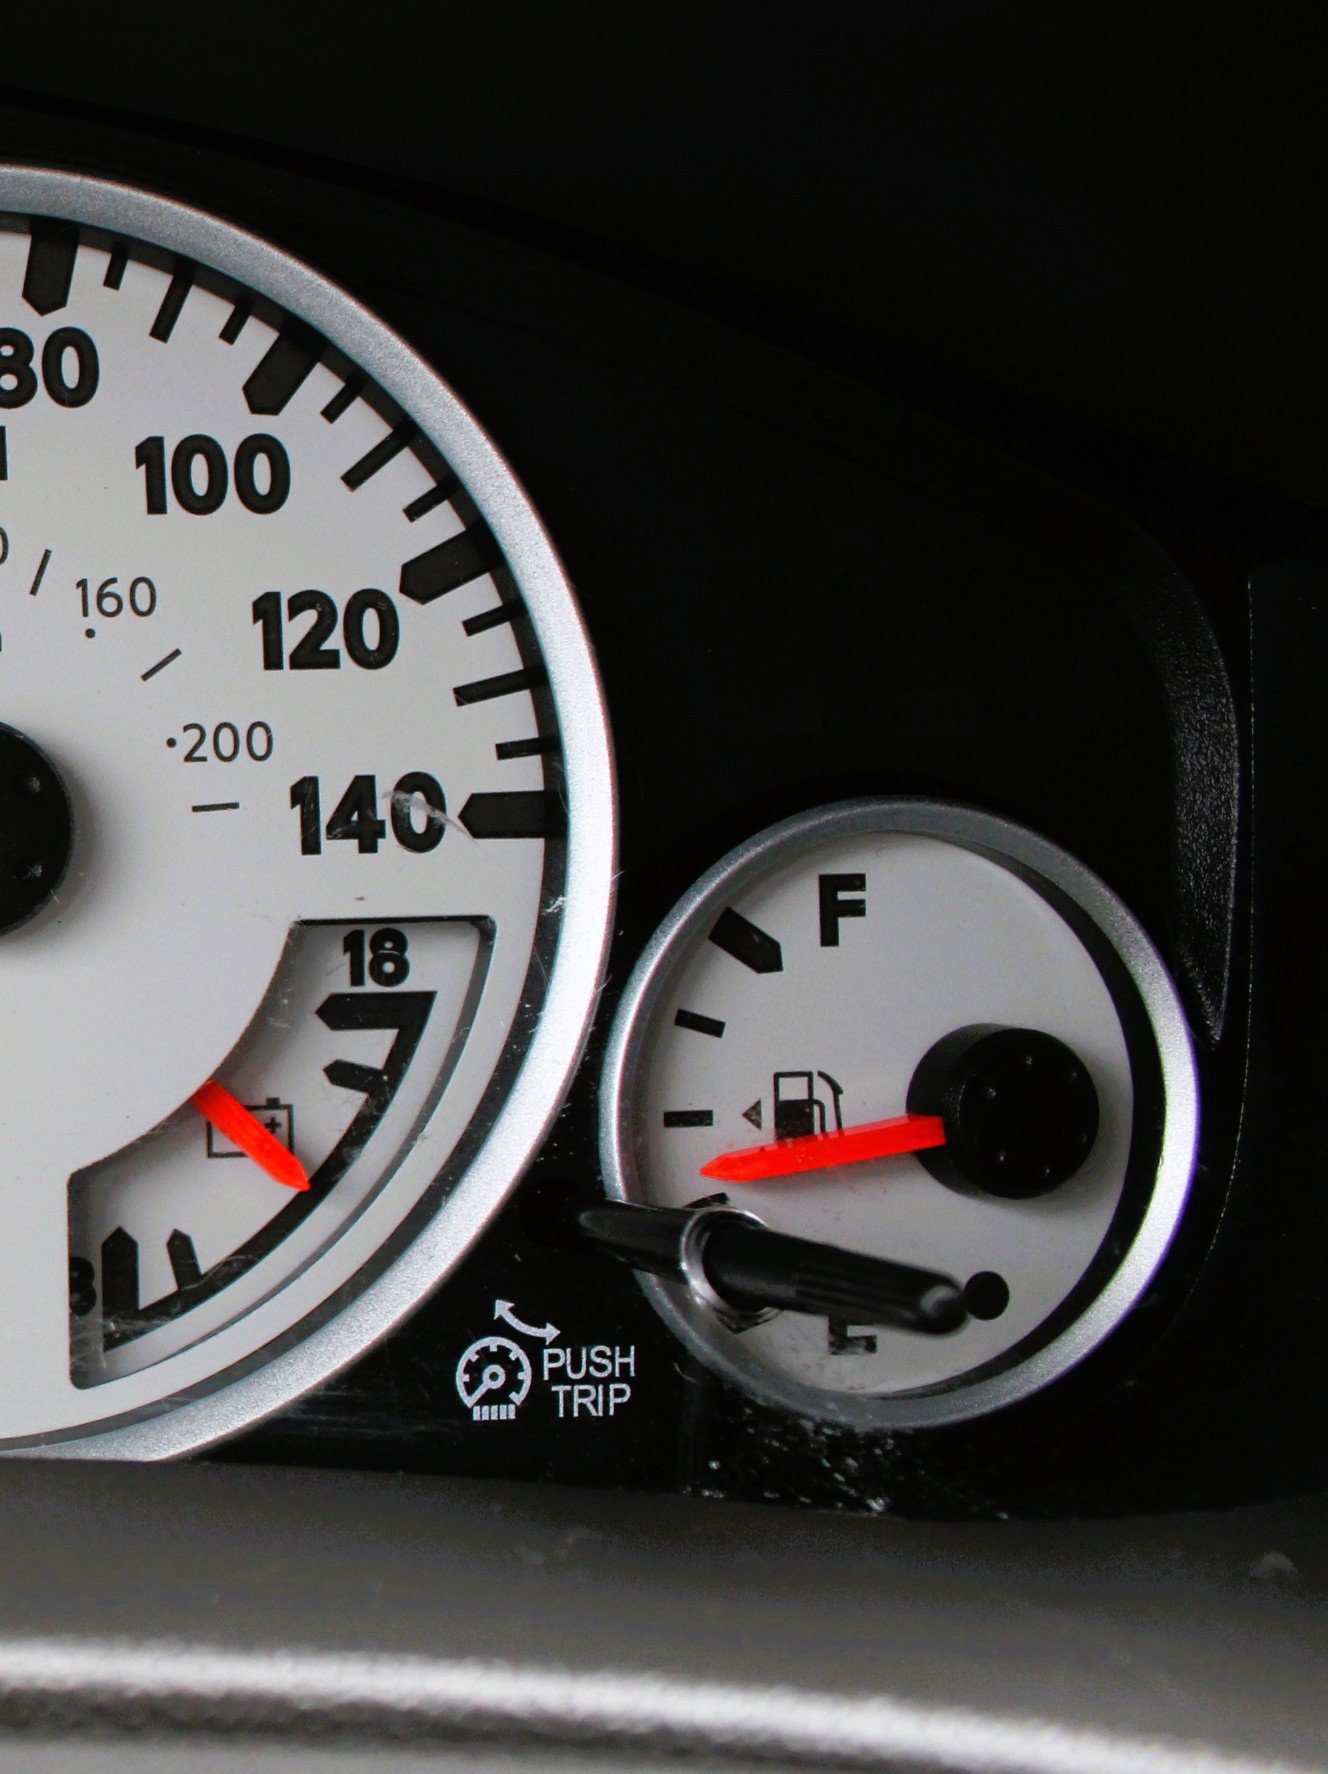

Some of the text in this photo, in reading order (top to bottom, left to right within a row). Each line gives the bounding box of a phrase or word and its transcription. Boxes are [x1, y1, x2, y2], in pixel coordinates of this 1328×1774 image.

[135, 433, 290, 515] 100
[77, 577, 156, 618] 160
[253, 588, 400, 670] 120
[182, 721, 274, 763] 200
[290, 771, 447, 856] 140
[819, 873, 867, 947] F
[342, 928, 410, 987] 18
[543, 1345, 636, 1380] PUSH
[551, 1383, 632, 1418] TRIP
